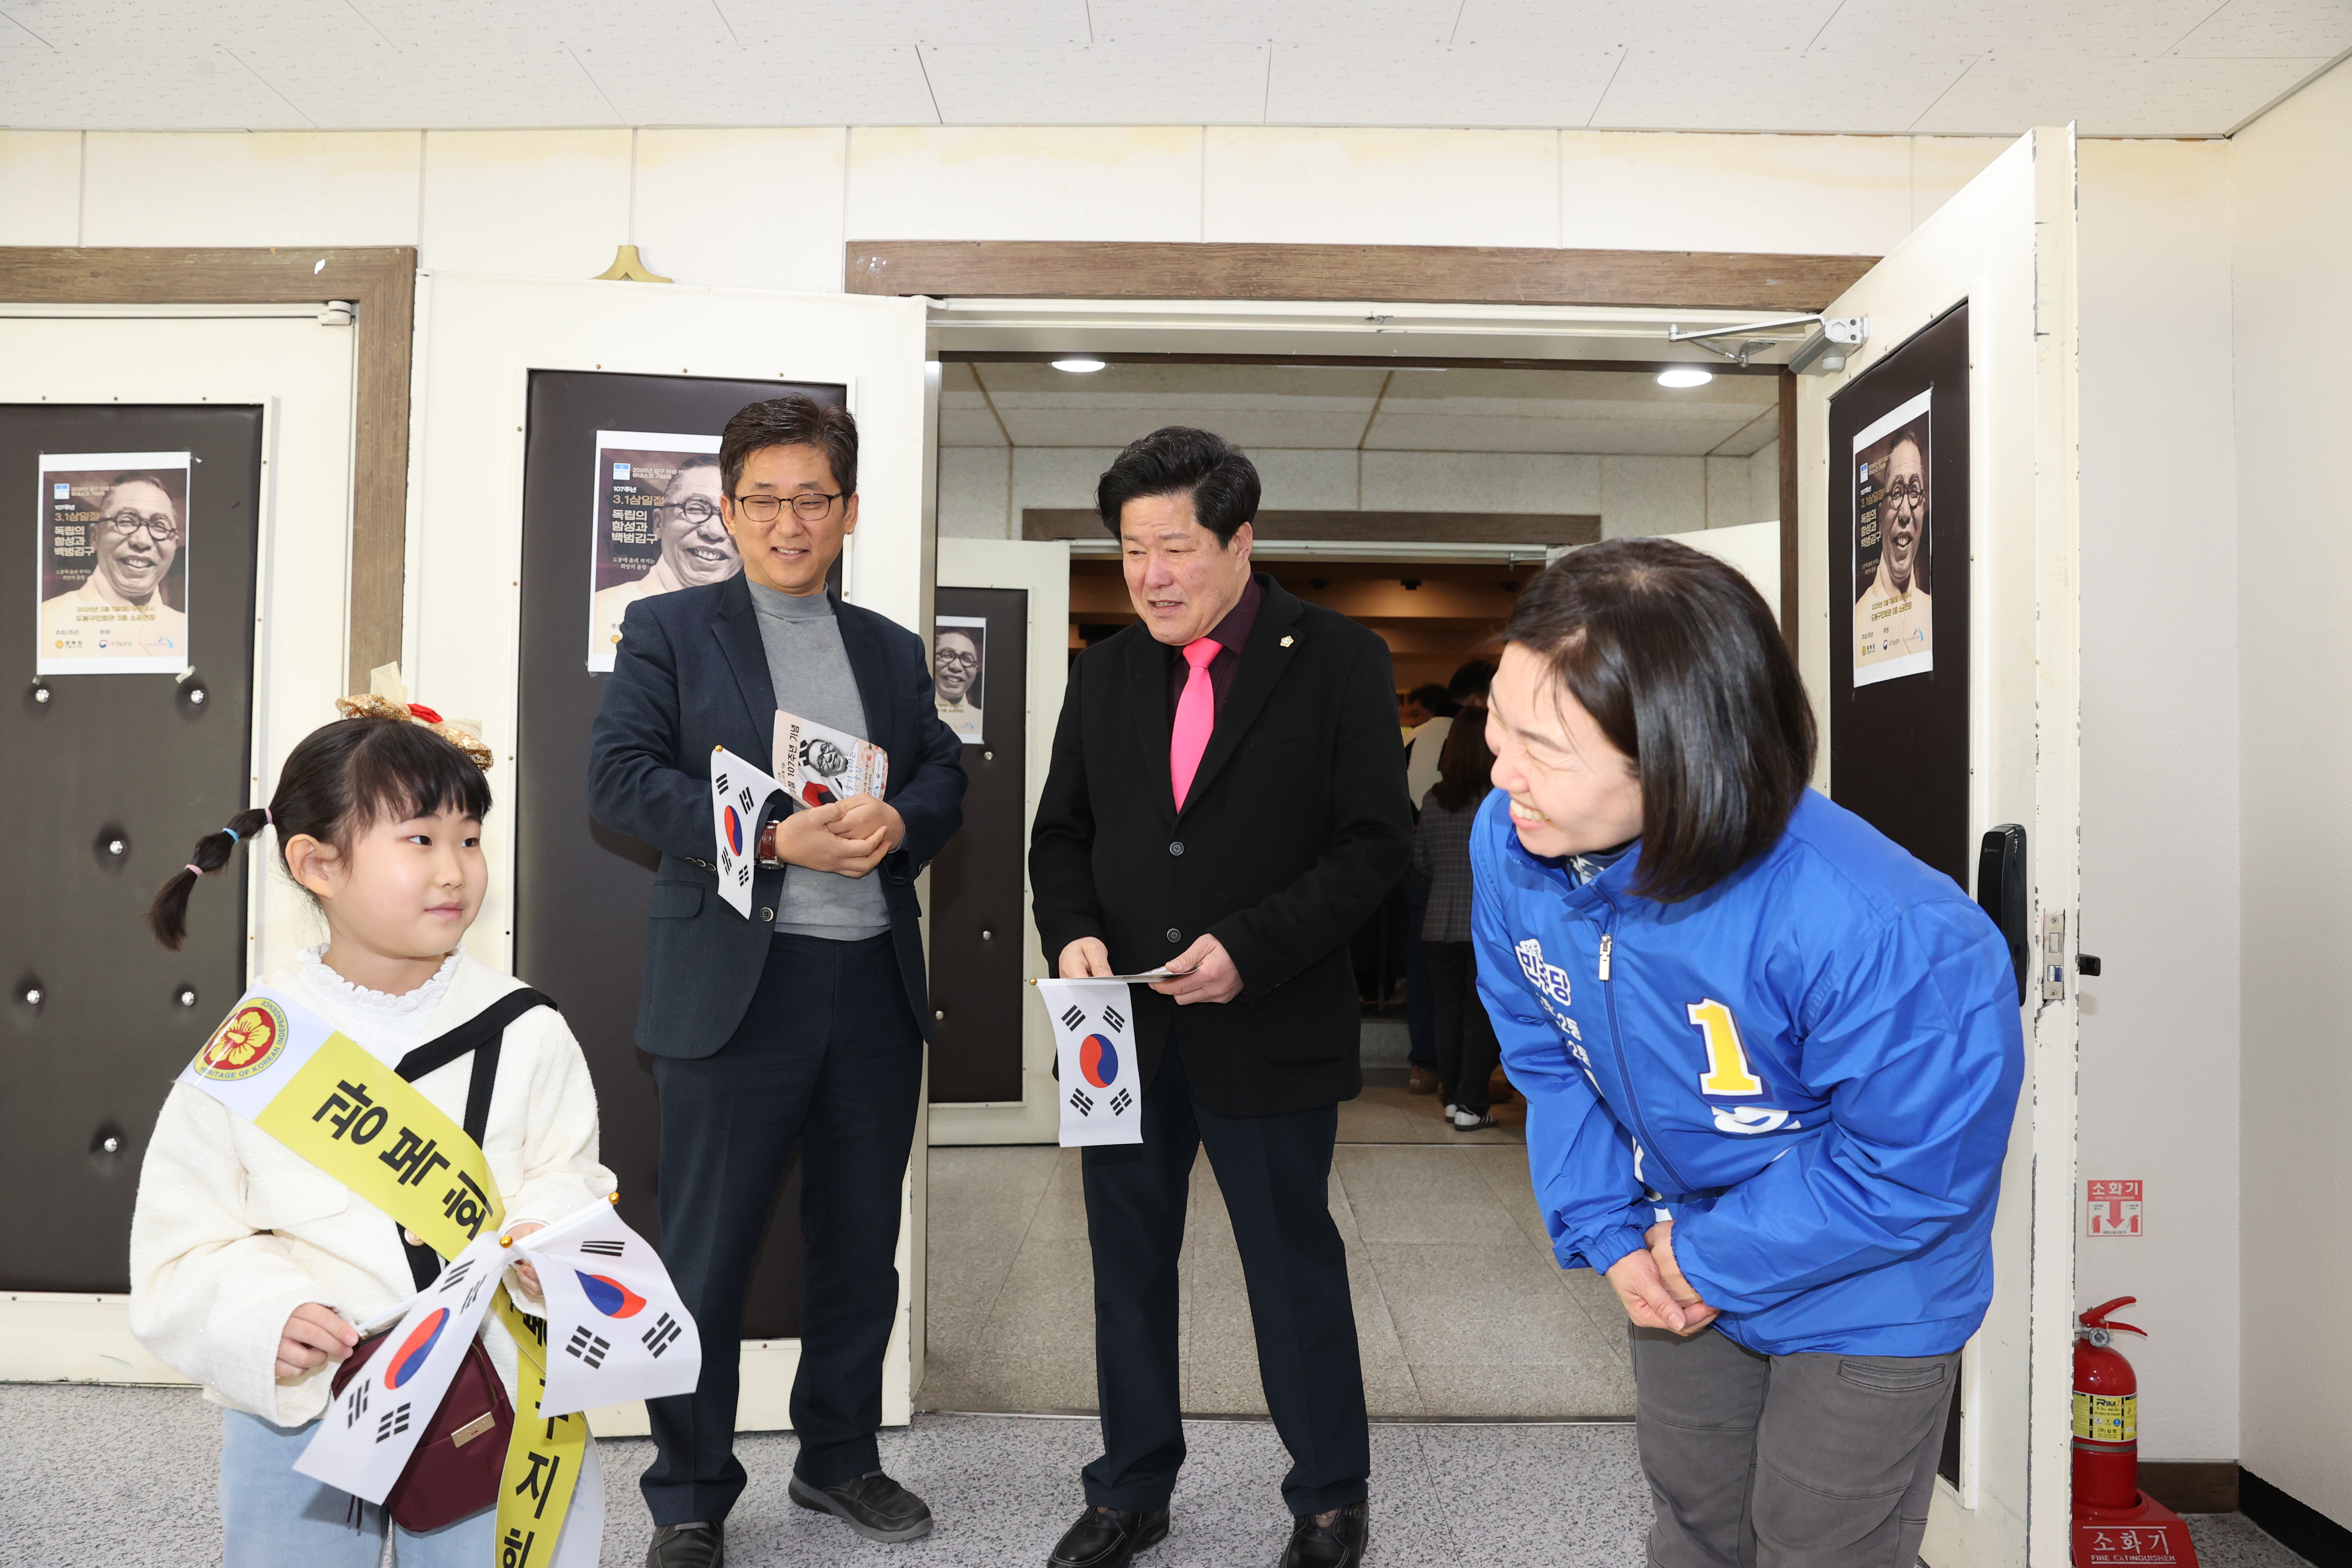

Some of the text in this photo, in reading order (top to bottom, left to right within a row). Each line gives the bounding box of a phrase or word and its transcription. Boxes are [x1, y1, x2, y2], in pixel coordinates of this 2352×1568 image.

[612, 495, 664, 506] 3.1삼일절
[1861, 488, 1884, 508] 3.1삼일절
[55, 511, 99, 521] 3.1삼일절
[612, 509, 647, 521] 독립의
[1861, 508, 1876, 524] 독립의
[54, 526, 85, 536] 독립의
[612, 521, 648, 532] 함성과
[1861, 521, 1877, 537] 함성과
[54, 536, 86, 546] 함성과
[612, 532, 658, 544] 백범김구
[1861, 531, 1881, 548] 백범김구
[54, 546, 95, 557] 백범김구
[790, 724, 799, 742] 기념
[787, 744, 797, 776] 107주년
[854, 766, 862, 783] 울림
[845, 775, 853, 792] 울려
[260, 1000, 286, 1045] INDEPENDENCE
[1687, 998, 1763, 1096] 1
[252, 1047, 281, 1072] KOREAN
[199, 1066, 236, 1078] HERITAGE
[2092, 1182, 2138, 1195] 소화기
[2093, 1530, 2169, 1555] 소화기
